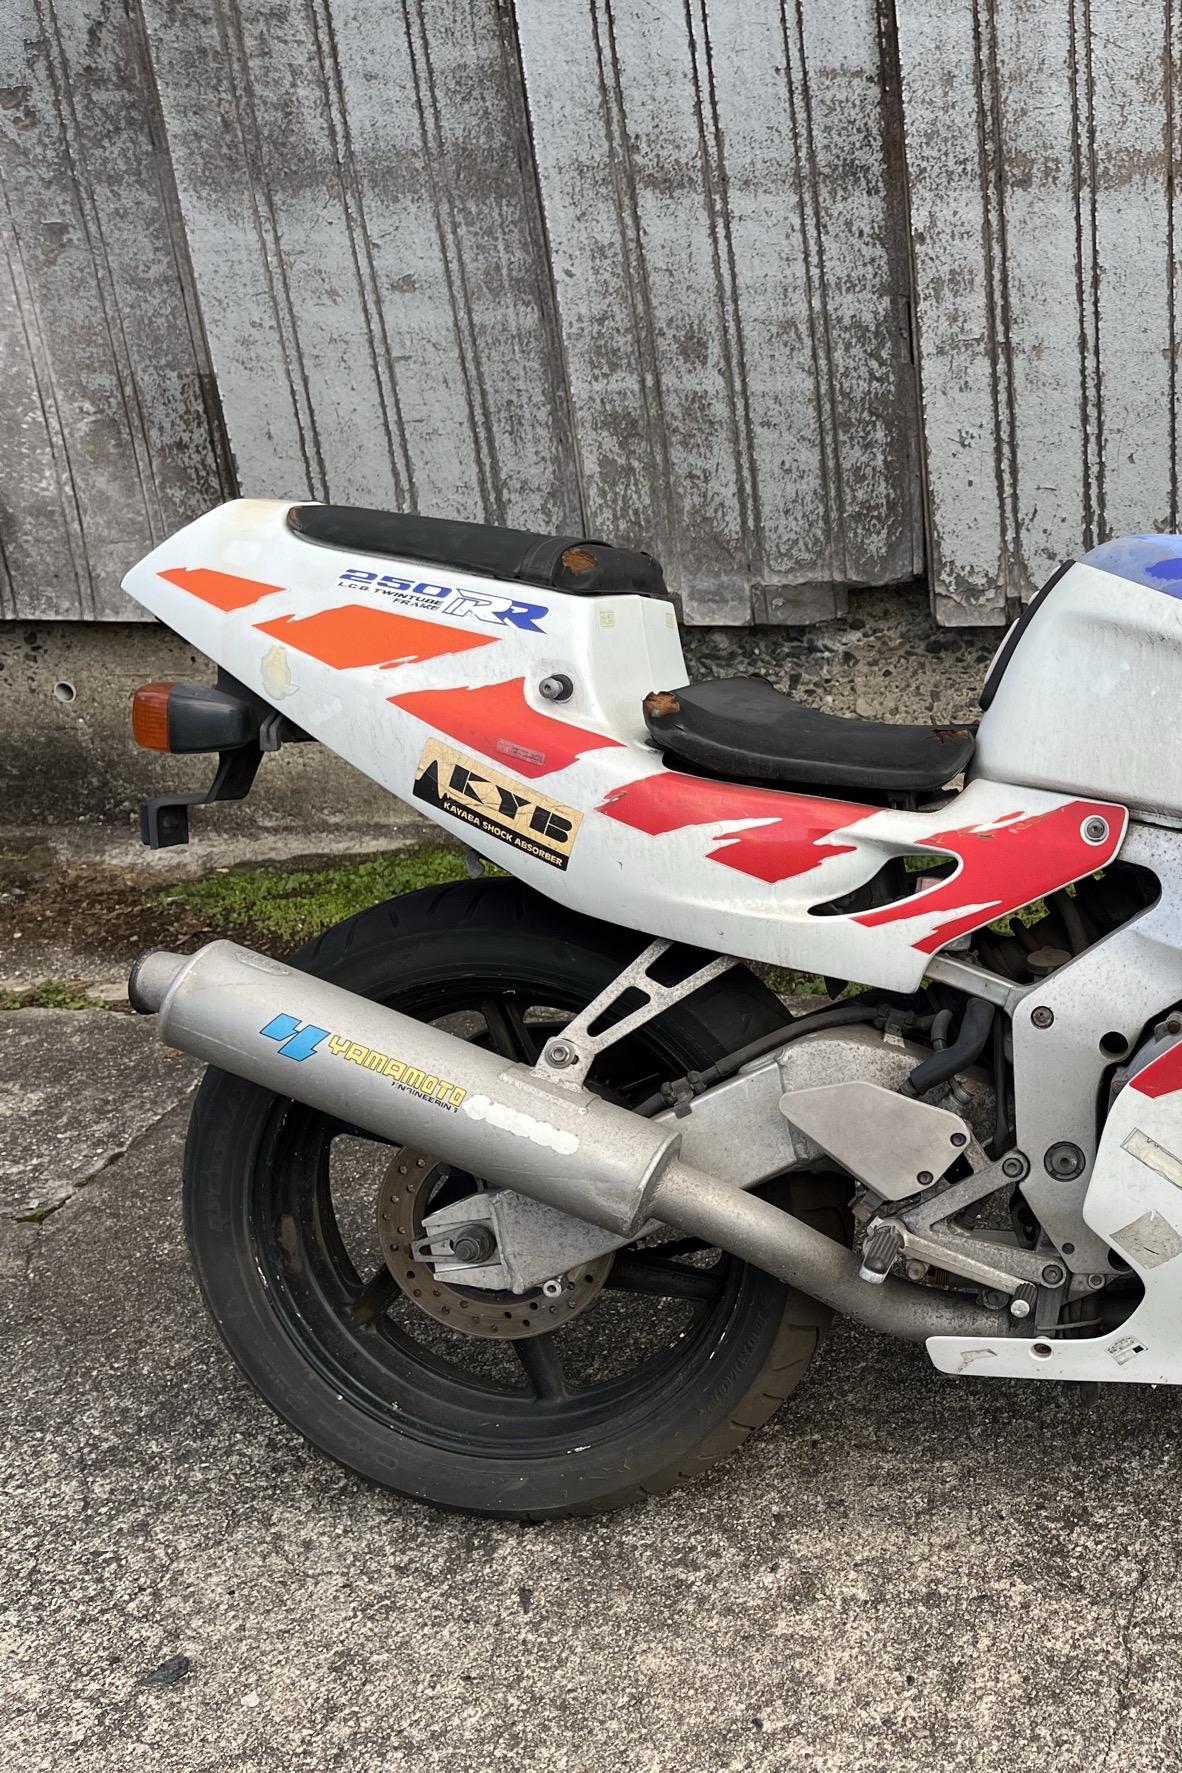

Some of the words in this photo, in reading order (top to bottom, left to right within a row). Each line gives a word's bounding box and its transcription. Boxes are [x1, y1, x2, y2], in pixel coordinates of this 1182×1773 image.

[374, 588, 445, 606] TWINTUBE
[392, 598, 441, 611] FRAME
[444, 802, 480, 826] KAYABA
[483, 821, 513, 843] SHOCK
[514, 838, 563, 867] ABSORBER
[449, 764, 573, 843] KYB
[328, 1035, 467, 1107] YAMAMOTO
